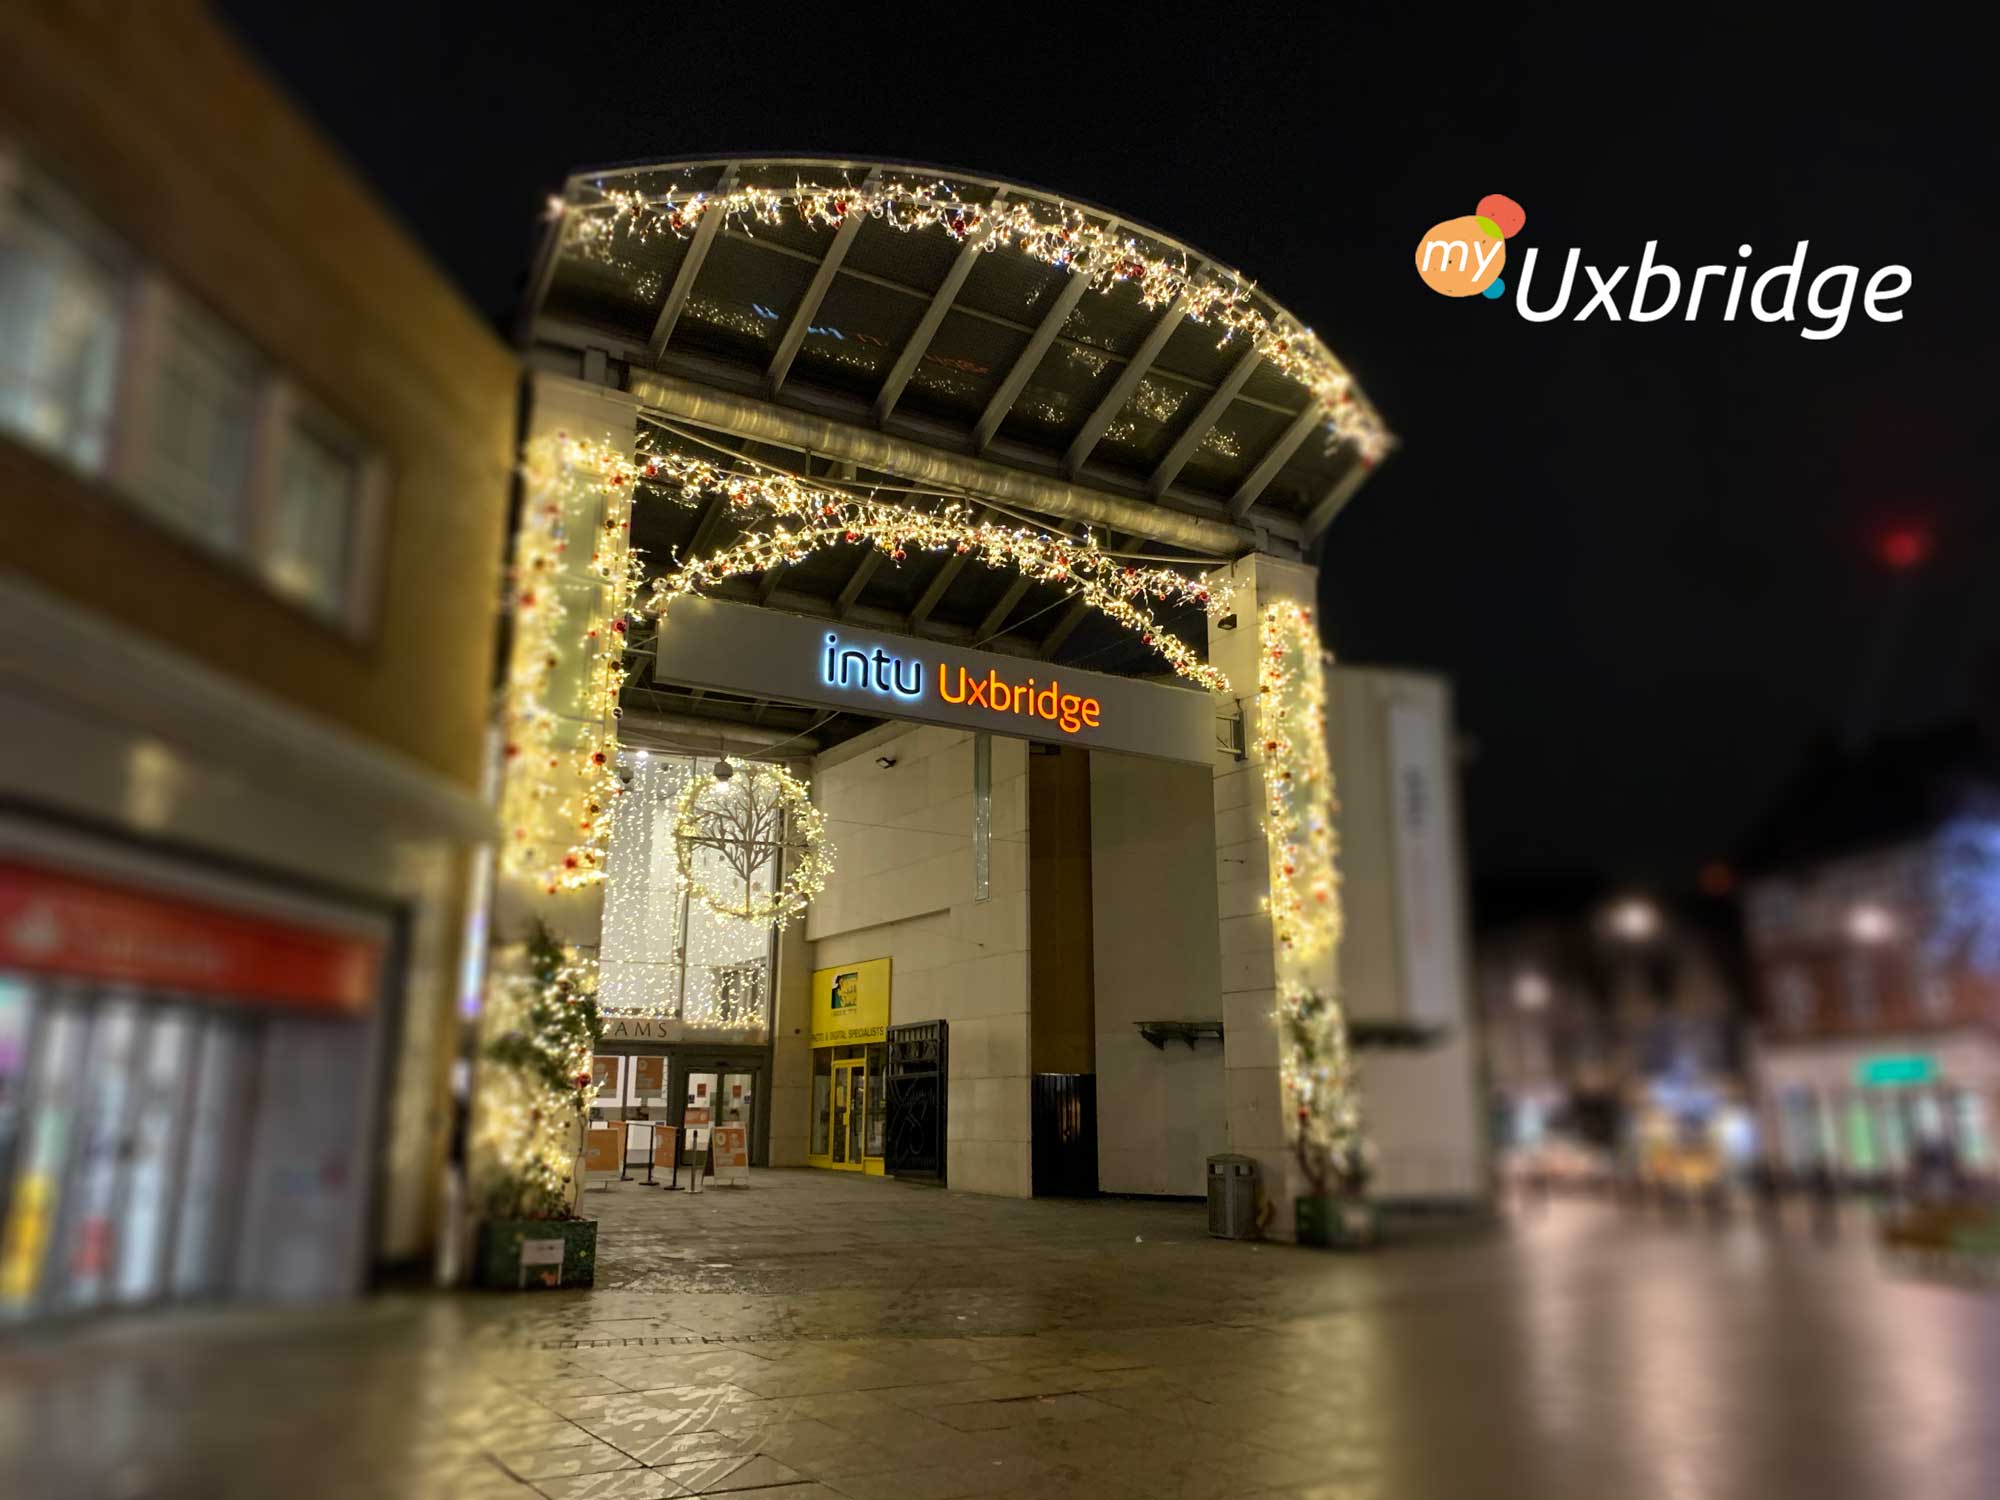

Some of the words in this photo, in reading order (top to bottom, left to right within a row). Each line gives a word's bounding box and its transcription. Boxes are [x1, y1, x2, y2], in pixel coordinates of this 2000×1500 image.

[825, 633, 922, 696] intu
[939, 663, 1101, 733] Uxbridge
[848, 1026, 884, 1039] SPECIALISTS
